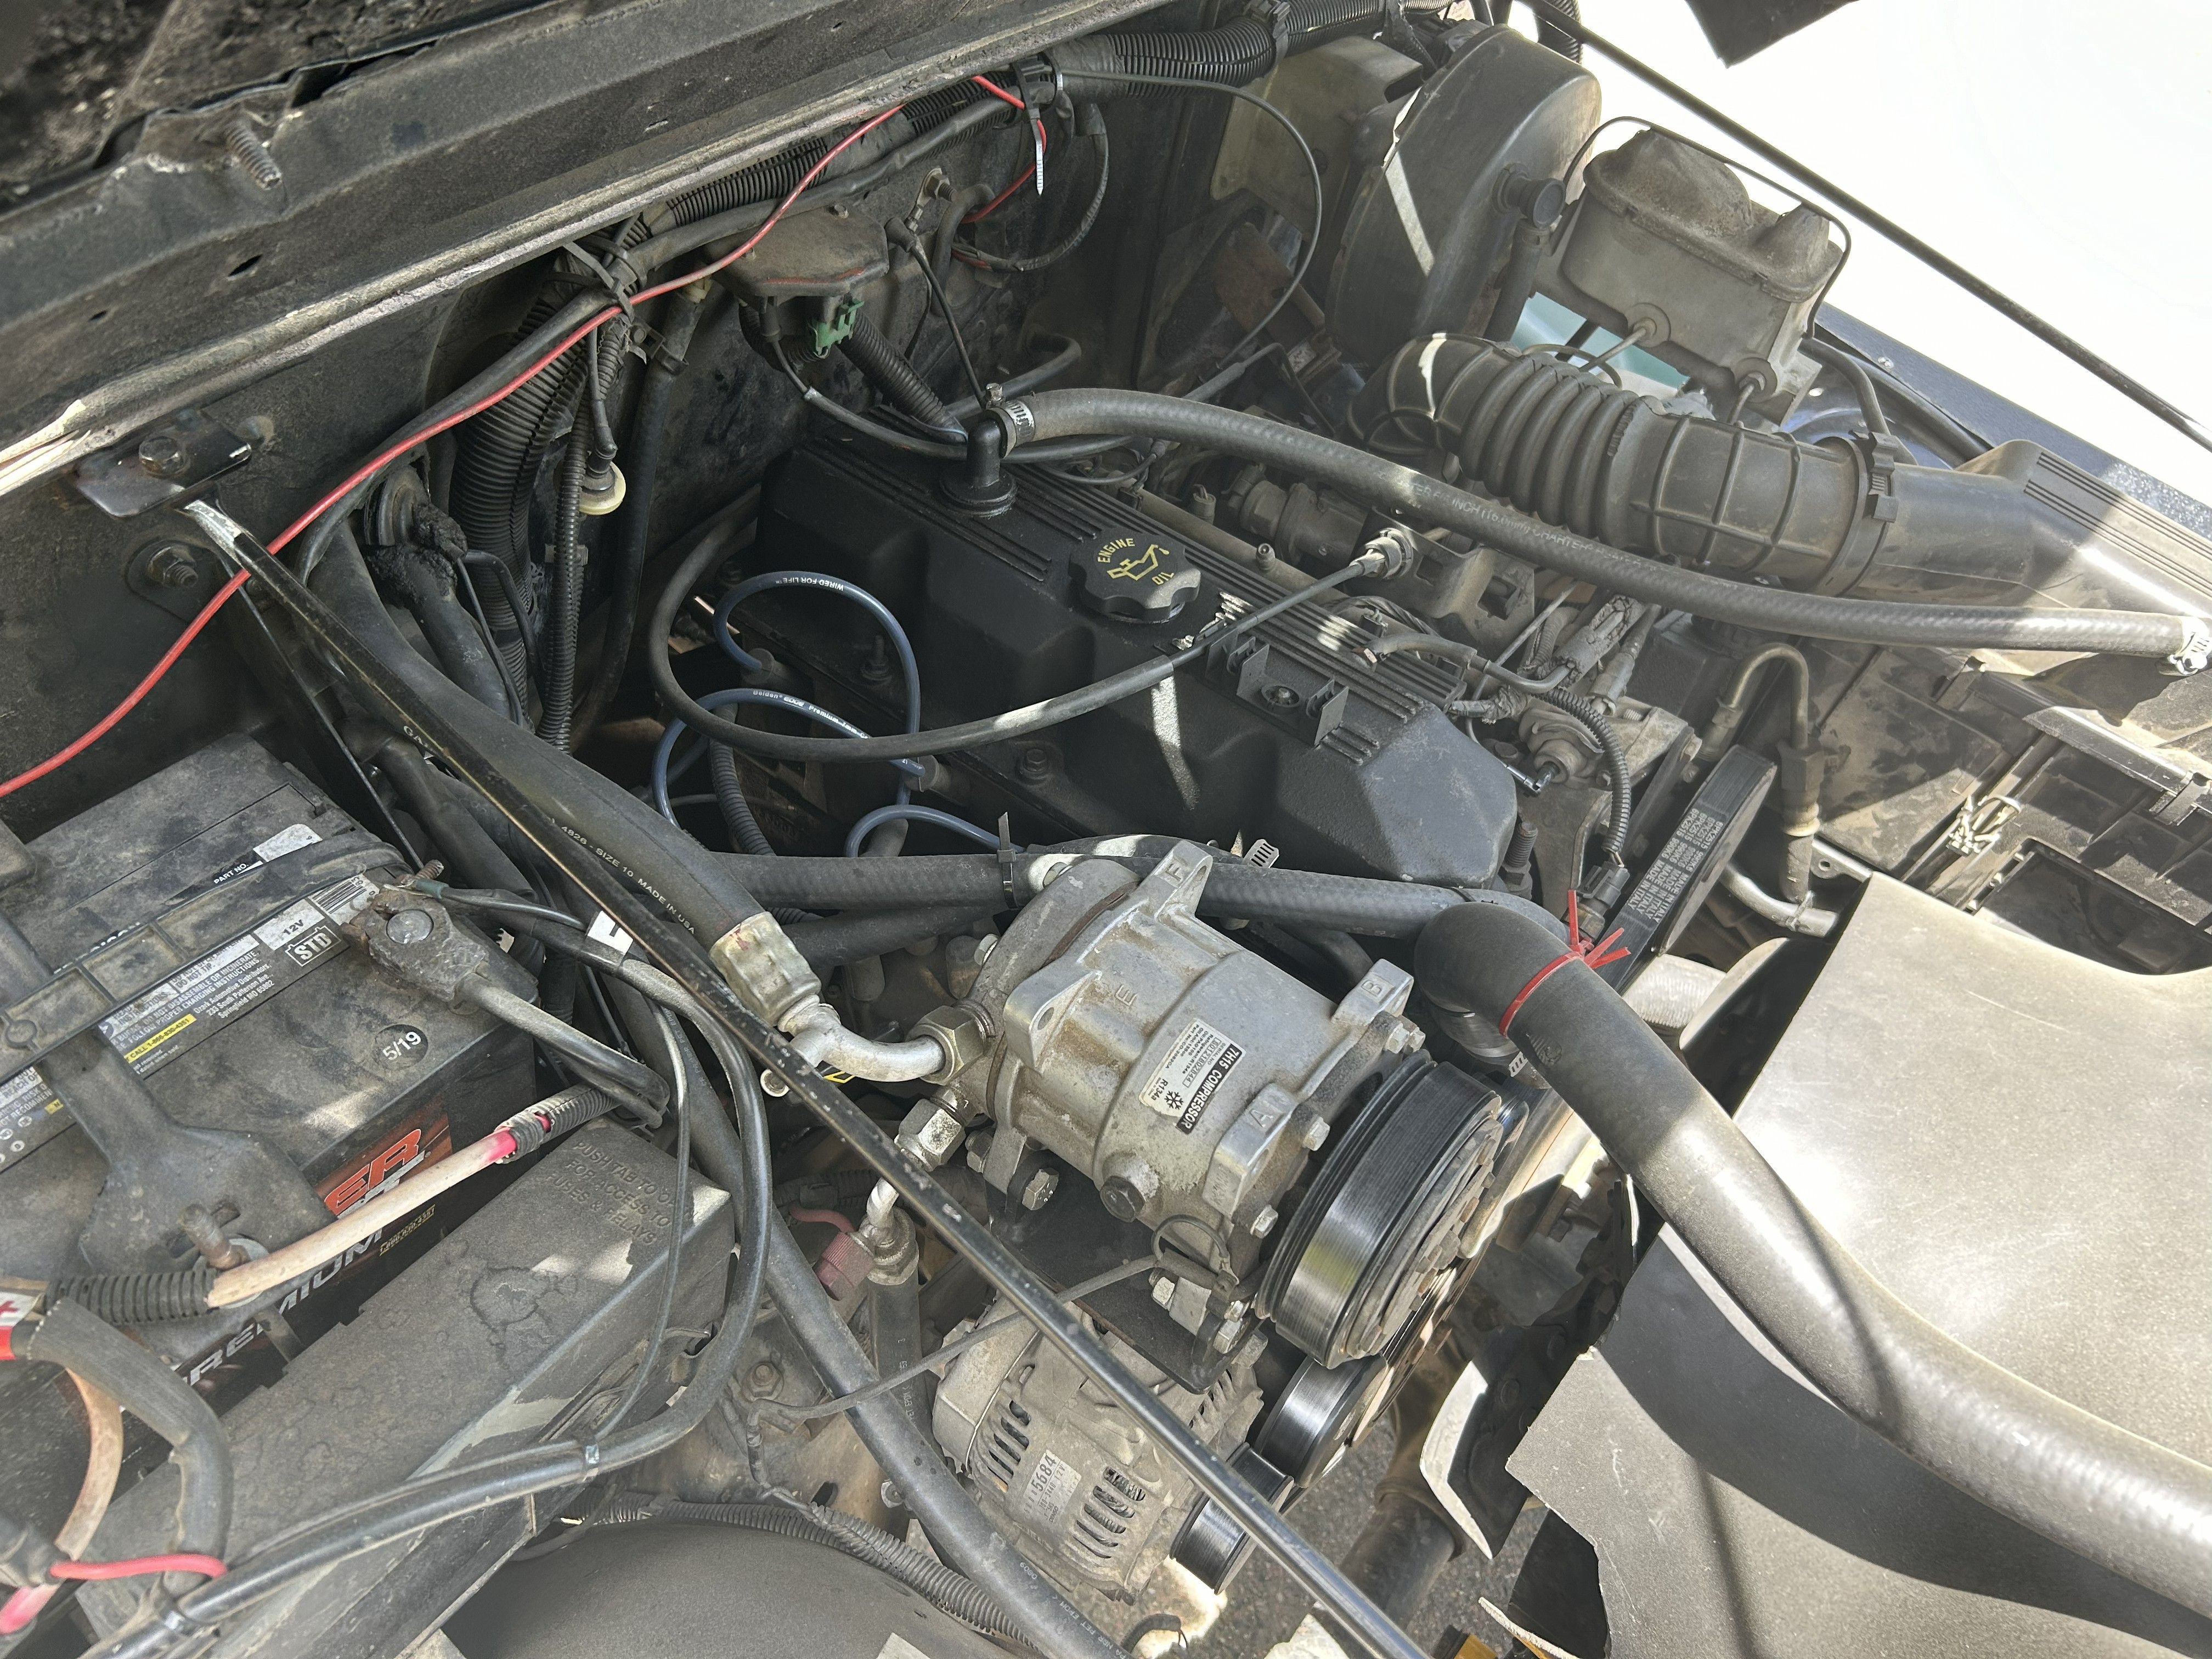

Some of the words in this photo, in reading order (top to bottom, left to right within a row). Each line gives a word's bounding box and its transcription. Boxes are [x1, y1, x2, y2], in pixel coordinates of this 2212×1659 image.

[1452, 498, 1480, 515] INCH
[1098, 538, 1136, 563] ENGINE
[819, 579, 844, 591] WIRED
[1152, 572, 1175, 585] OIL
[809, 705, 839, 723] Premium
[1676, 808, 1700, 838] 6PK2515
[1685, 812, 1708, 842] 6PK2515
[213, 871, 234, 884] PART
[234, 862, 249, 873] NO.
[561, 826, 588, 845] 4826
[595, 848, 620, 867] SIZE
[623, 867, 634, 877] 10
[637, 878, 666, 905] MADE
[666, 904, 677, 915] IN
[678, 914, 695, 934] USA
[1646, 859, 1666, 882] MADE
[1654, 864, 1673, 887] MADE
[1665, 868, 1682, 891] MADE
[1640, 882, 1651, 890] IN
[1649, 884, 1660, 895] IN
[1657, 889, 1668, 899] IN
[1628, 888, 1645, 910] ITALY
[1636, 893, 1654, 915] ITALY
[1646, 898, 1662, 919] ITALY
[1664, 895, 1674, 904] IN
[1652, 901, 1669, 923] ITALY
[283, 919, 304, 934] 12V
[294, 932, 332, 960] STD
[189, 970, 203, 981] NOT
[154, 1006, 168, 1019] NOT
[168, 978, 213, 1009] DISASSEMBLE
[210, 973, 222, 981] OR
[194, 1001, 211, 1013] Ozark
[209, 983, 240, 1004] Automotive
[206, 1006, 219, 1016] 233
[217, 996, 235, 1009] South
[232, 980, 259, 998] Patterson
[218, 996, 249, 1019] Springfield
[246, 990, 258, 1000] MO
[256, 980, 274, 994] 65802
[1362, 980, 1384, 998] B
[128, 1023, 157, 1043] FOLLOW
[156, 1006, 183, 1025] PROPER
[182, 985, 216, 1009] CHARGING
[214, 958, 262, 989] INSTRUCTIONS.
[130, 1046, 149, 1058] CALL
[382, 1031, 421, 1060] 5/19
[1213, 1042, 1226, 1058] SERIAL
[1207, 1057, 1215, 1065] NO
[1219, 1047, 1239, 1070] 7H15
[1151, 1079, 1169, 1101] R134a
[1181, 1069, 1222, 1130] COMPRESSOR
[1249, 1107, 1274, 1128] A
[572, 1140, 614, 1168] PUSH
[611, 1162, 638, 1184] TAB
[638, 1178, 657, 1195] TO
[565, 1159, 596, 1180] FOR
[595, 1181, 650, 1216] ACCESS
[650, 1210, 671, 1228] TO
[545, 1173, 590, 1203] FUSES
[604, 1209, 657, 1245] RELAYS
[1049, 1505, 1059, 1523] DENSO
[1059, 1601, 1080, 1620] EPDM
[1080, 1621, 1096, 1635] PET
